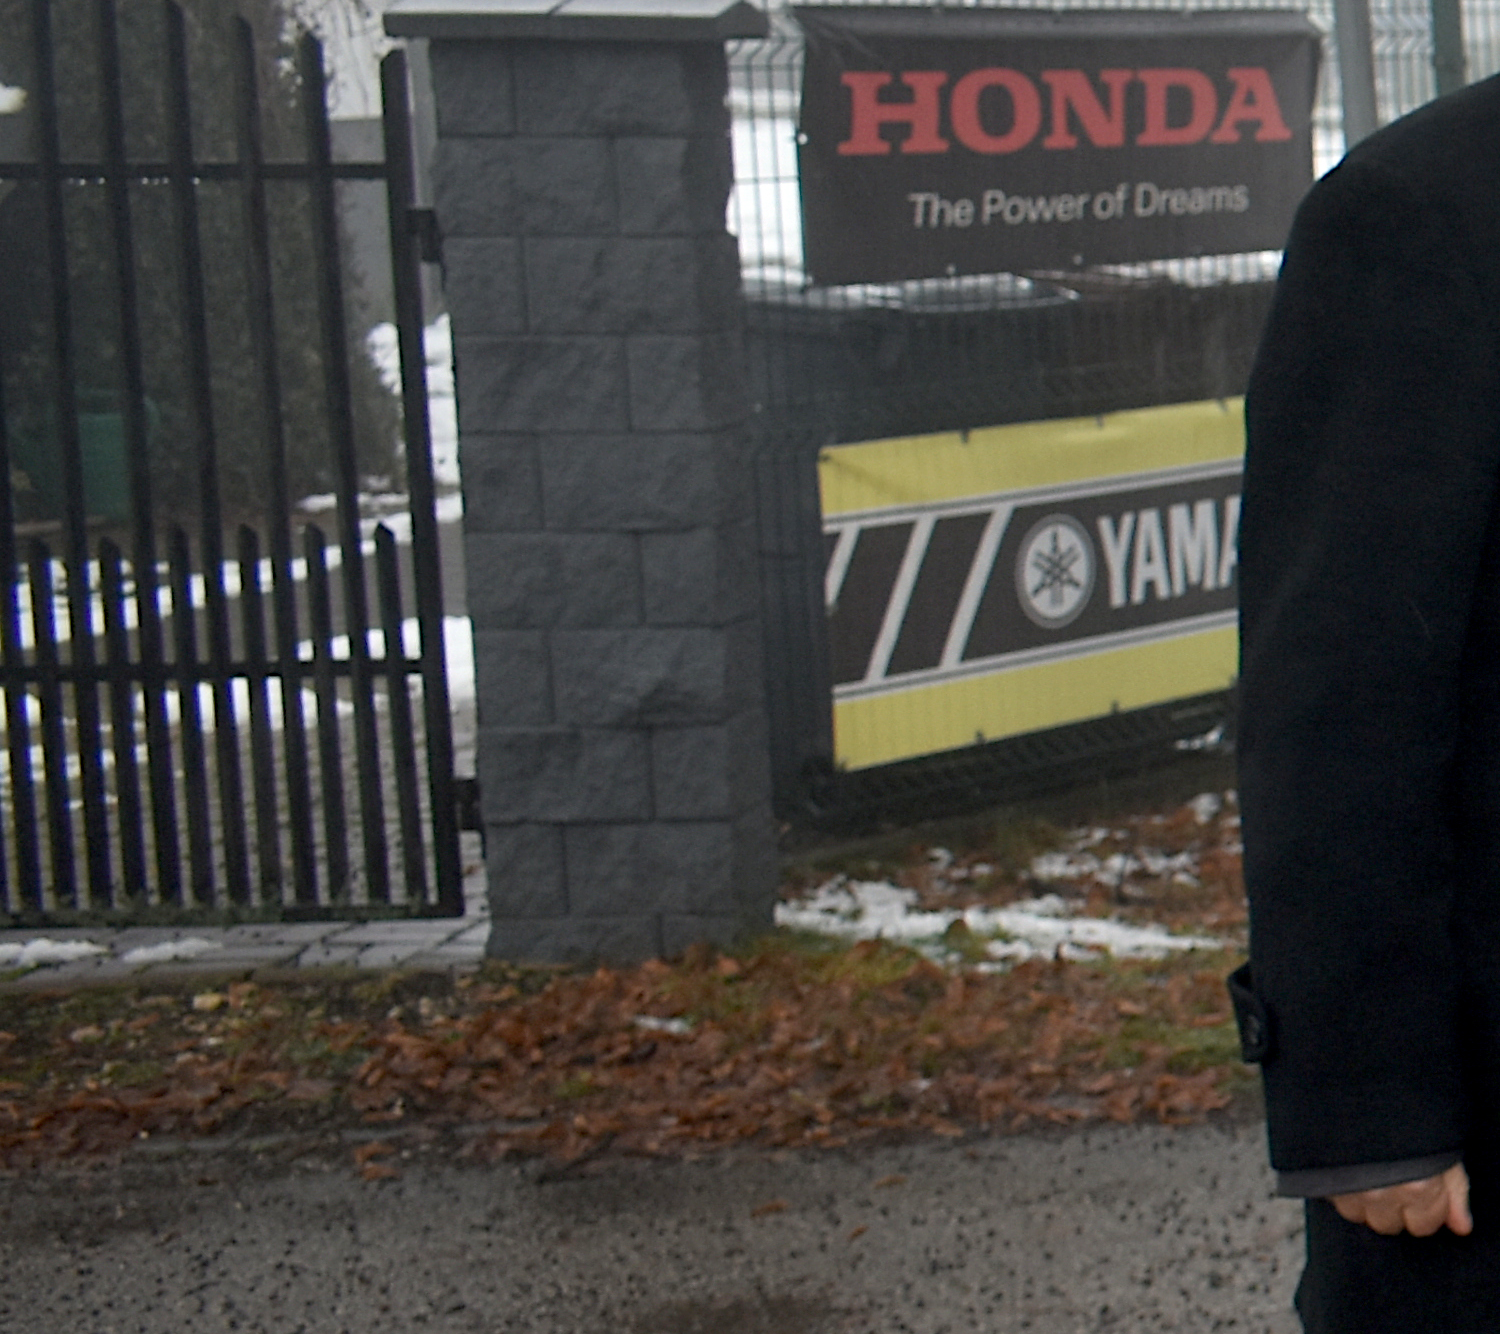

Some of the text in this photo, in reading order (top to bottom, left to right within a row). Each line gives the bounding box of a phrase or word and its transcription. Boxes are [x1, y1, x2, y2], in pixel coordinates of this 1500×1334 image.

[837, 67, 1293, 156] HONDA
[906, 182, 1250, 229] The Power of Dreams
